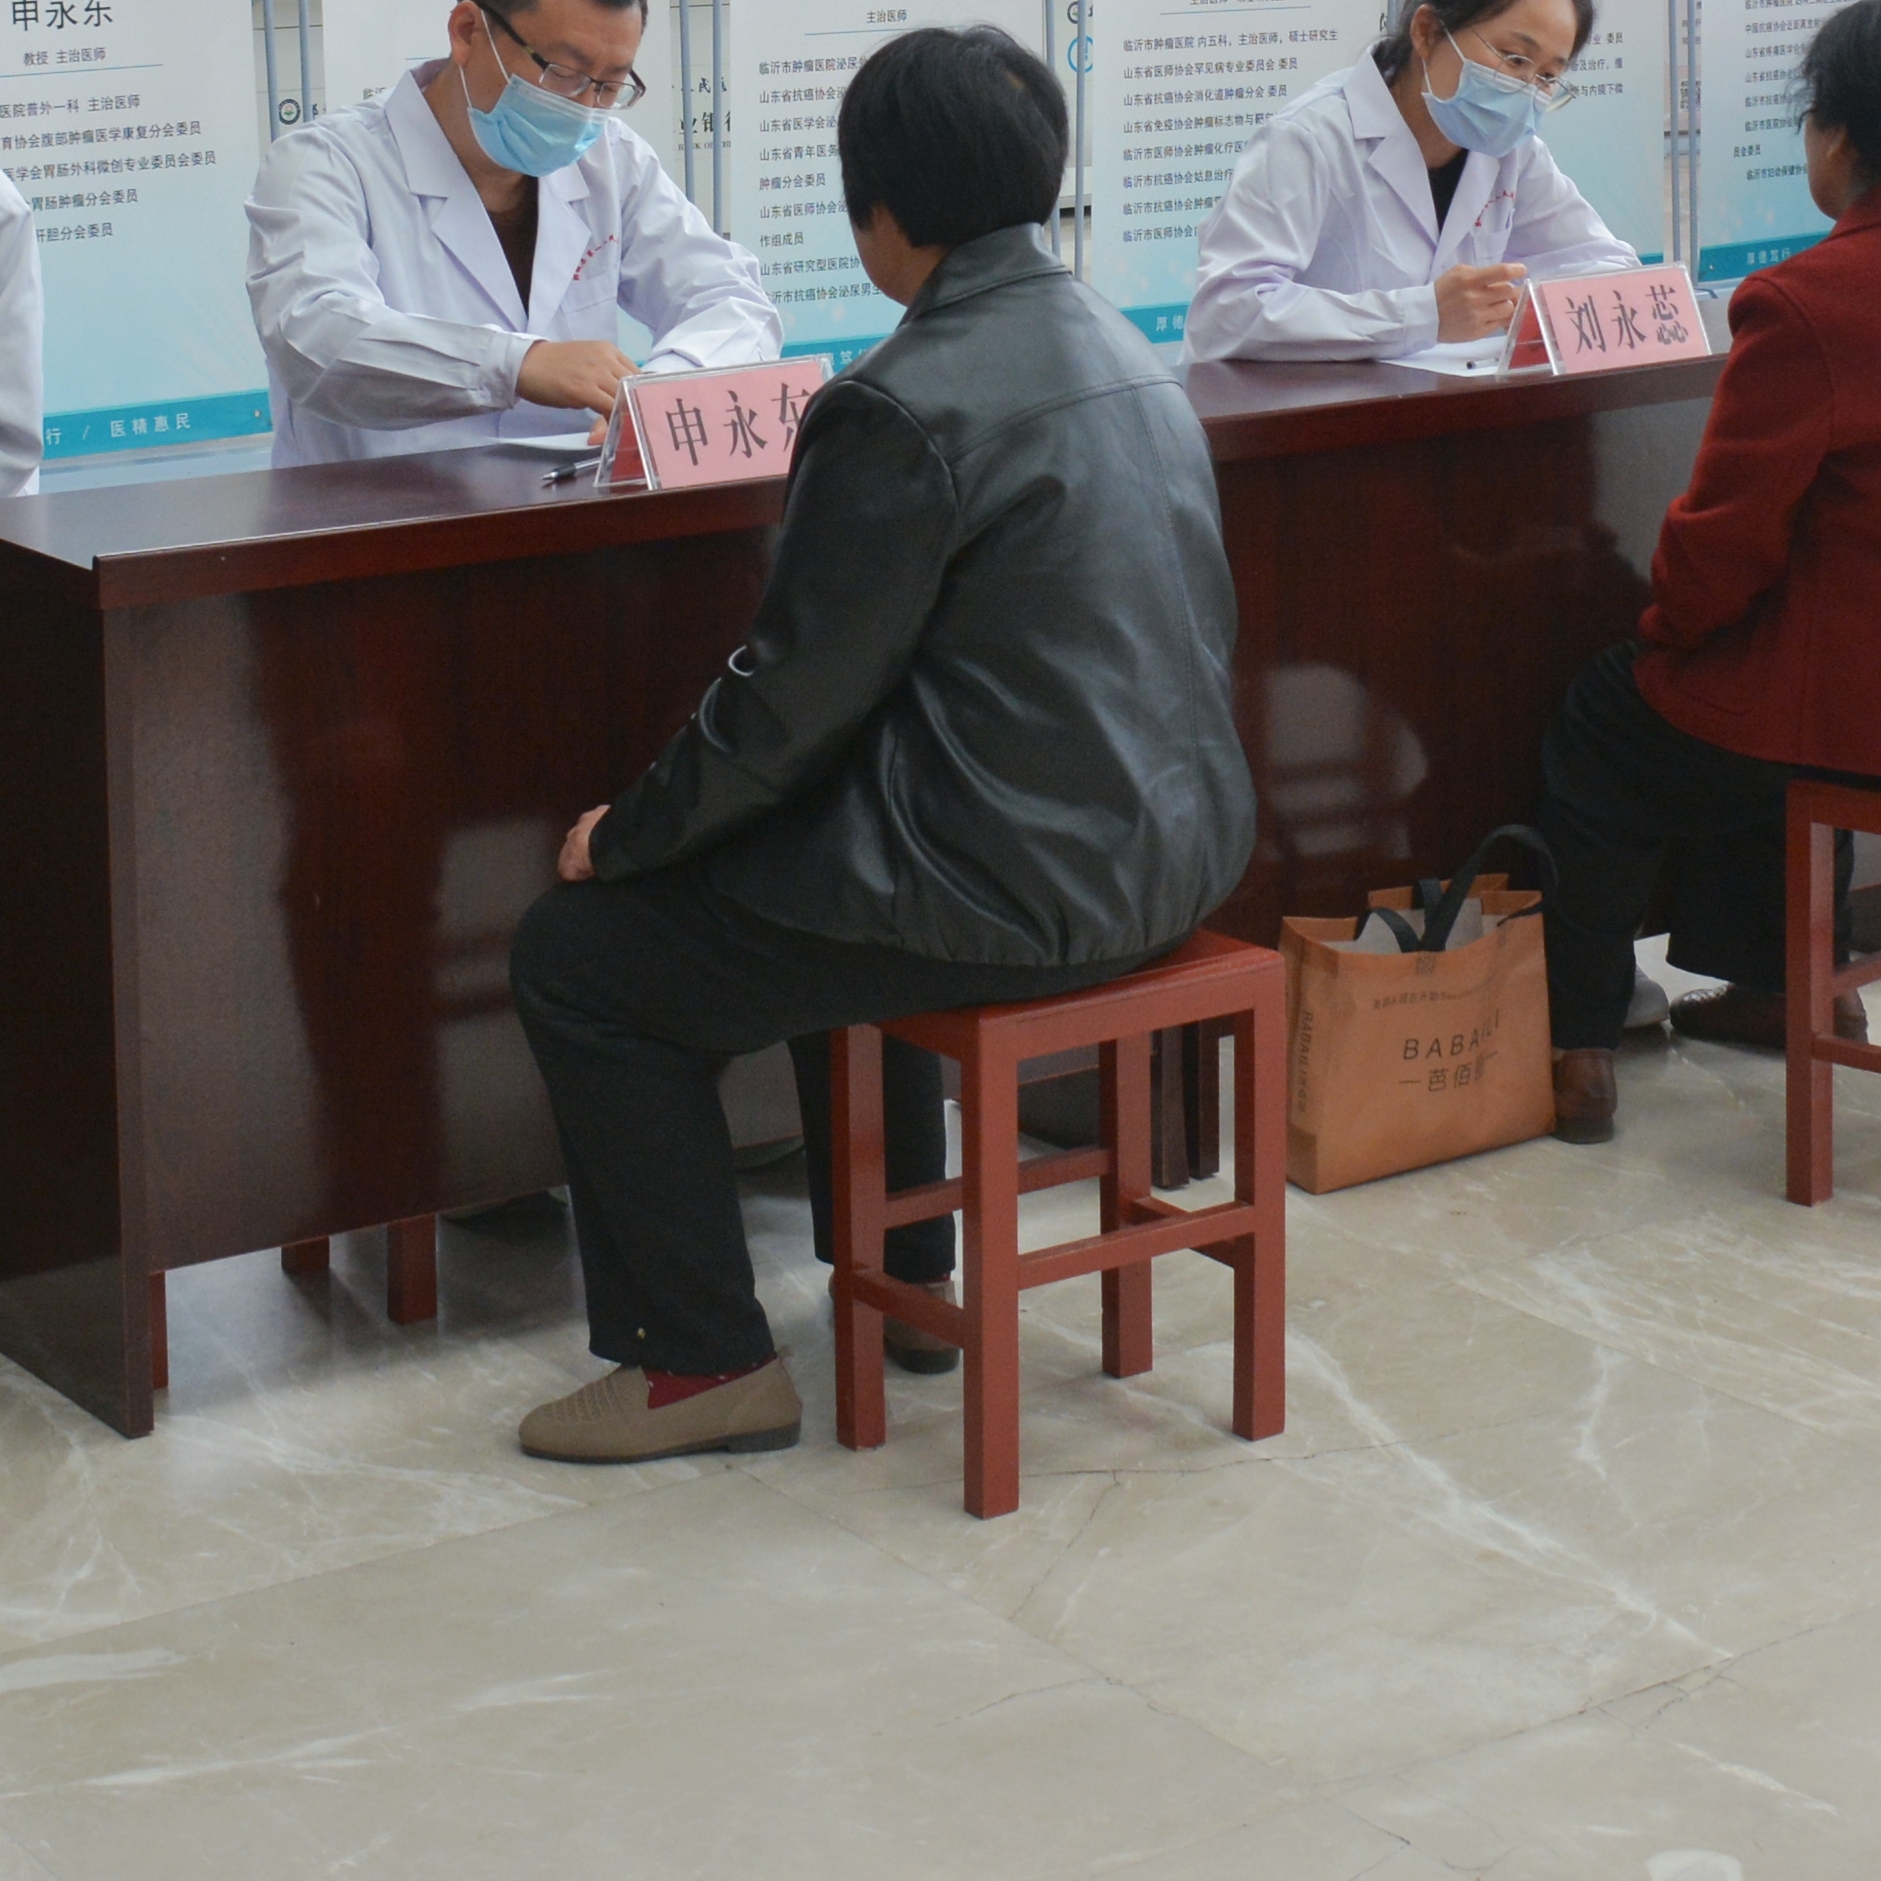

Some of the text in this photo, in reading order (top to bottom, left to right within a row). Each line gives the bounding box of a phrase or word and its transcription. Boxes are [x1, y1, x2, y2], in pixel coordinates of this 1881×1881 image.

[866, 9, 908, 25] 主治医师
[1123, 36, 1195, 52] 临沂市肿瘤医院
[23, 47, 106, 66] 教授 主治医师
[1278, 57, 1298, 70] 委员
[88, 94, 141, 112] 主治医师
[1124, 84, 1287, 107] 山东省抗癌协会消化道肿瘤分会 委员
[759, 173, 826, 191] 肿瘤分会委员
[760, 232, 804, 248] 作组成员
[1565, 285, 1689, 356] 刘永蕊
[110, 412, 192, 439] 医精惠民
[665, 382, 810, 467] 申永东
